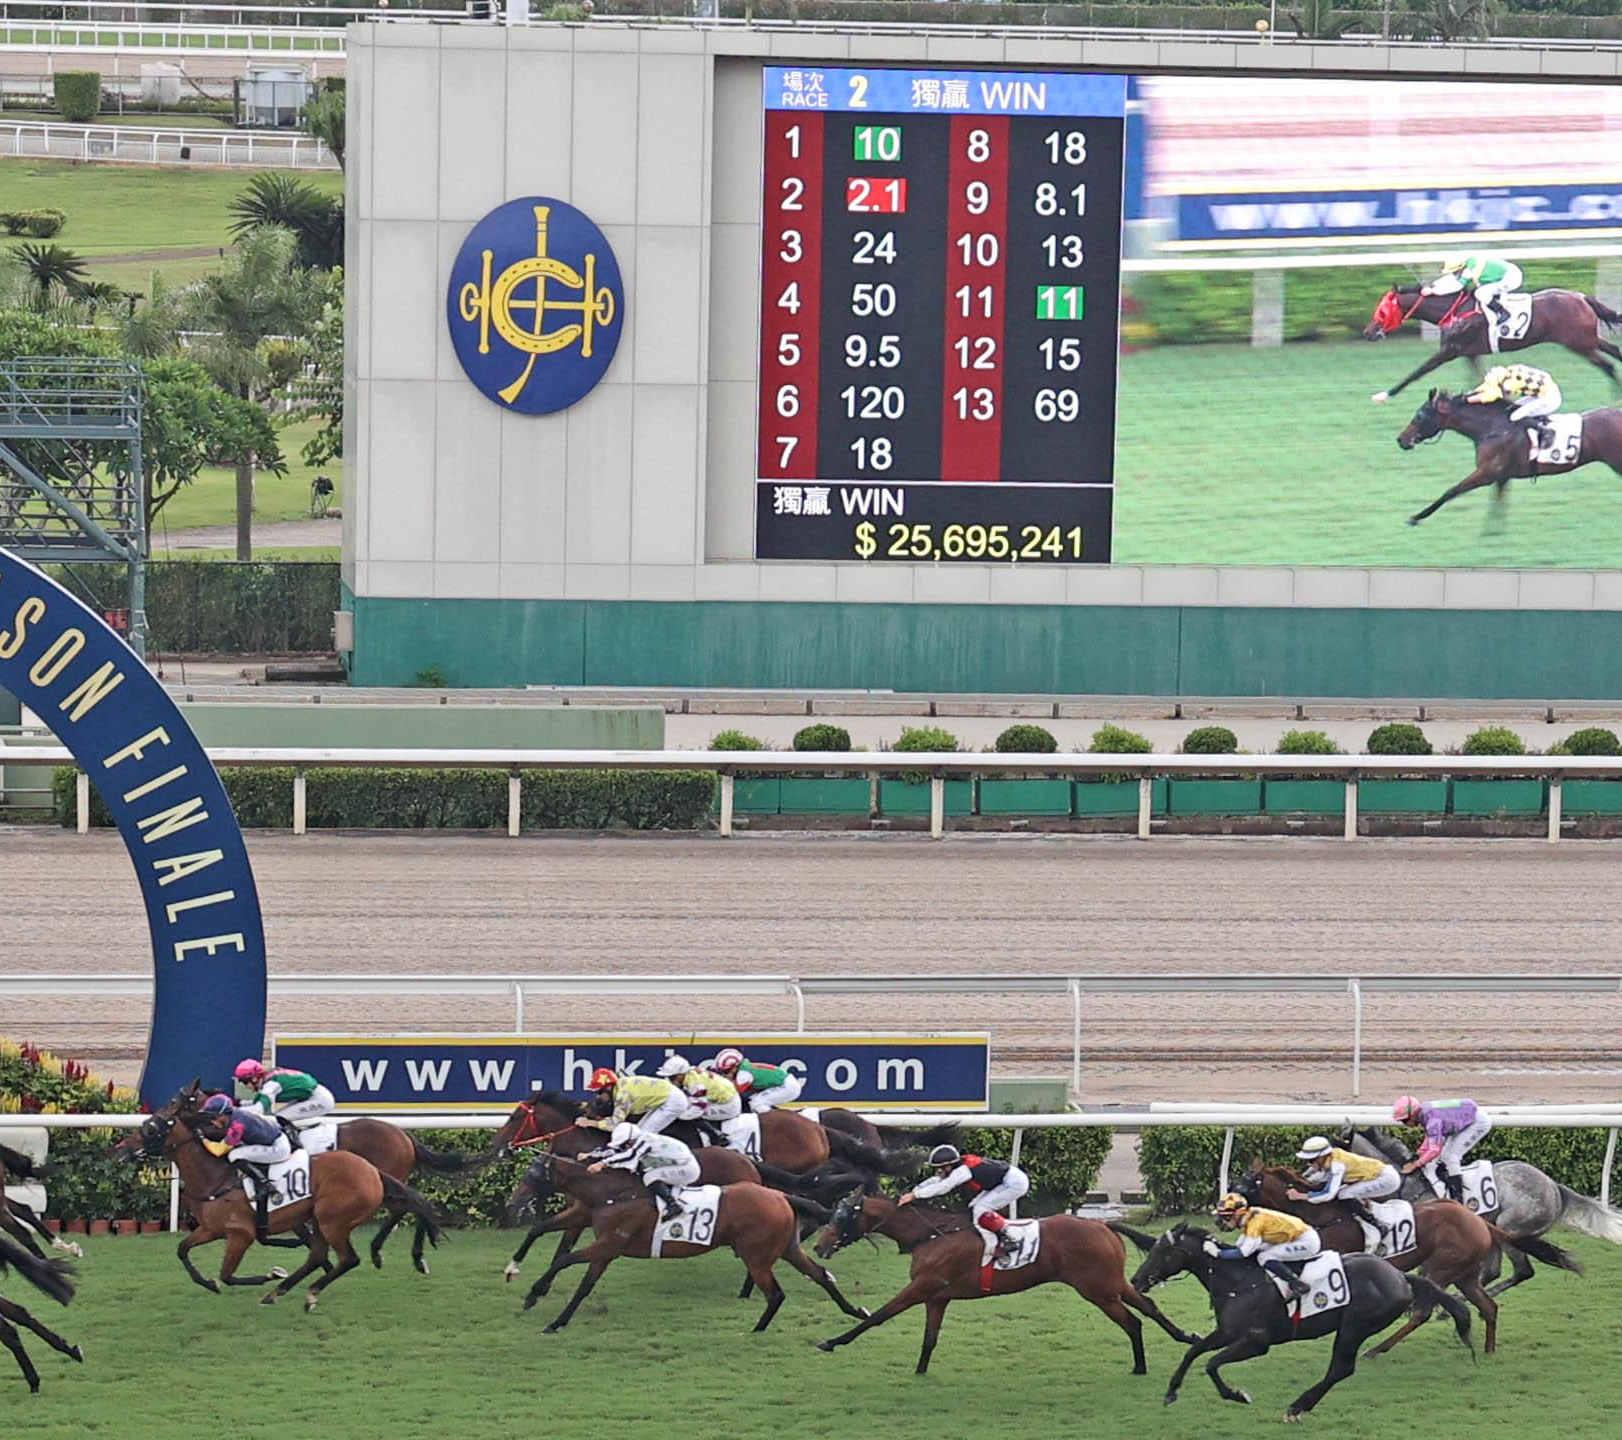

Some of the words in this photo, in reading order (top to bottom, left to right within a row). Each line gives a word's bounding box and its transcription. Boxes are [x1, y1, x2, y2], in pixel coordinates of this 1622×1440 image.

[781, 90, 829, 108] RACE
[783, 71, 825, 92] 場次
[848, 75, 868, 108] 2
[911, 78, 971, 109] 獨贏
[980, 80, 1047, 111] WIN
[785, 125, 799, 158] 1
[858, 127, 900, 152] 10
[967, 129, 989, 162] 8
[1045, 131, 1086, 165] 18
[781, 177, 803, 210] 2
[848, 179, 903, 212] 2.1
[966, 181, 989, 214] 9
[1035, 182, 1086, 216] 8.1
[780, 230, 802, 263] 3
[852, 231, 897, 264] 24
[957, 233, 998, 266] 10
[1042, 234, 1083, 268] 13
[778, 282, 801, 314] 4
[852, 283, 896, 317] 50
[955, 285, 992, 318] 11
[1040, 287, 1078, 320] 11
[1514, 312, 1528, 337] 2
[778, 333, 800, 366] 5
[845, 334, 901, 368] 9.5
[954, 336, 996, 369] 12
[1039, 338, 1080, 371] 15
[777, 384, 799, 417] 6
[841, 386, 905, 419] 120
[953, 387, 994, 420] 13
[1035, 389, 1079, 422] 69
[776, 436, 798, 468] 7
[851, 437, 892, 470] 18
[1565, 427, 1579, 461] 5
[774, 486, 832, 515] 獨贏
[840, 487, 904, 515] WIN
[855, 522, 877, 560] $
[887, 524, 1082, 561] 25,695,241
[102, 725, 246, 962] FINALE
[341, 1048, 925, 1093] www.hkcom
[744, 1132, 760, 1161] 4
[283, 1167, 307, 1200] 10
[1480, 1176, 1497, 1209] 6
[689, 1207, 714, 1242] 13
[1390, 1219, 1416, 1254] 12
[1328, 1268, 1346, 1305] 9
